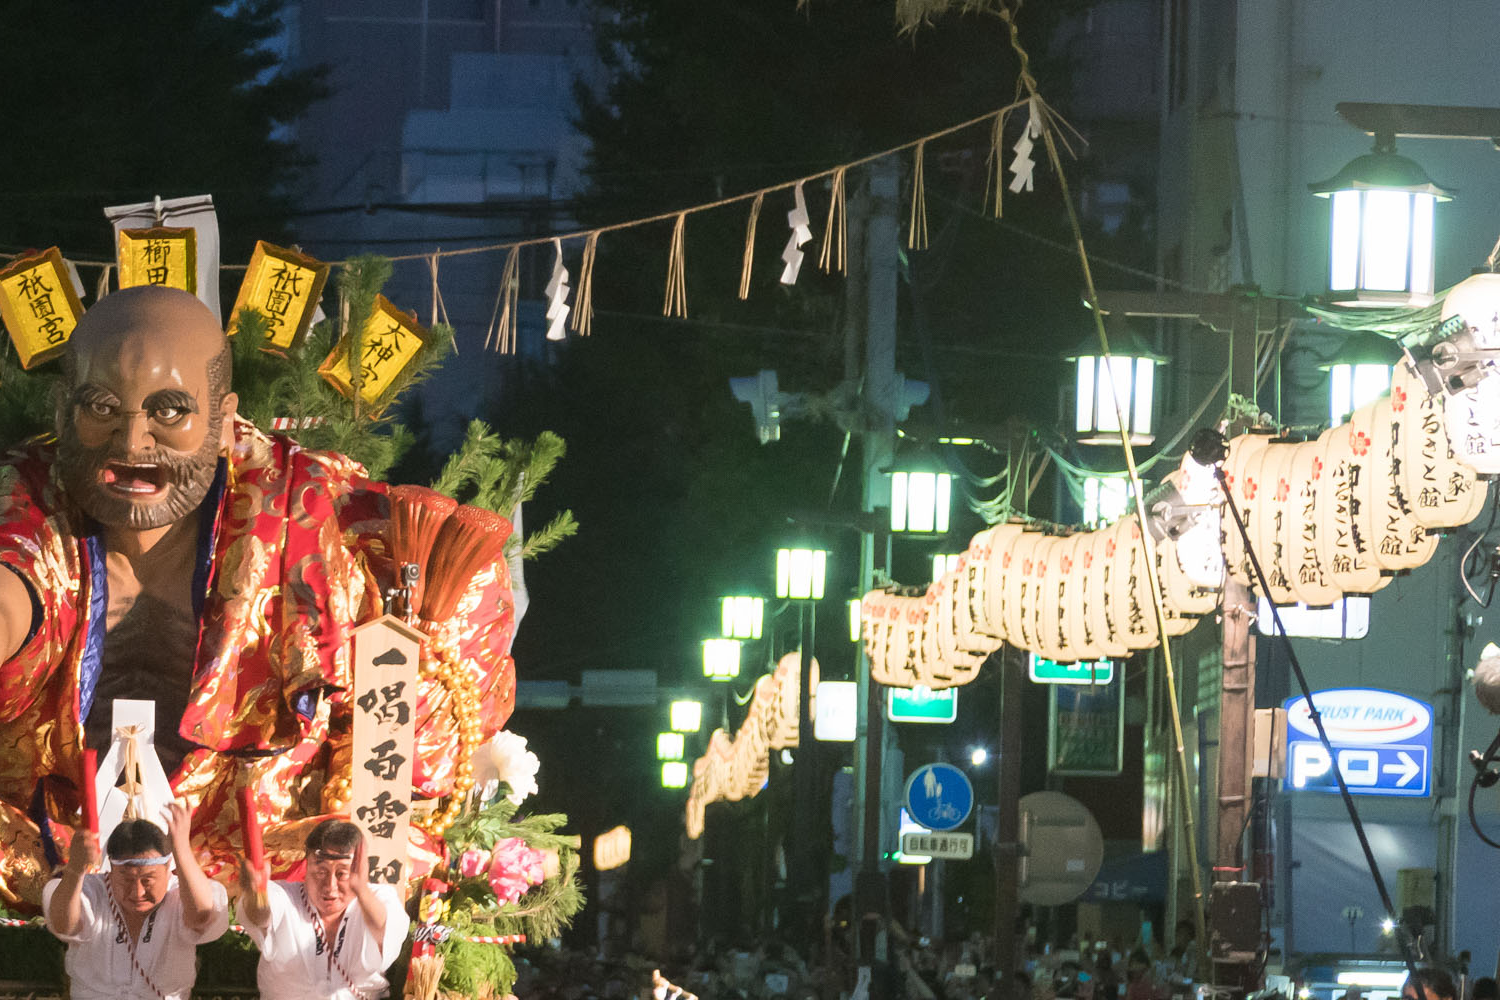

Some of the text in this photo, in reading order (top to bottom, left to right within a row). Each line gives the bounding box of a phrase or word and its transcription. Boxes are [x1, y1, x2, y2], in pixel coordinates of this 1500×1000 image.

[143, 239, 170, 285] 櫛田
[1364, 707, 1406, 721] PARK
[1294, 745, 1332, 788] P
